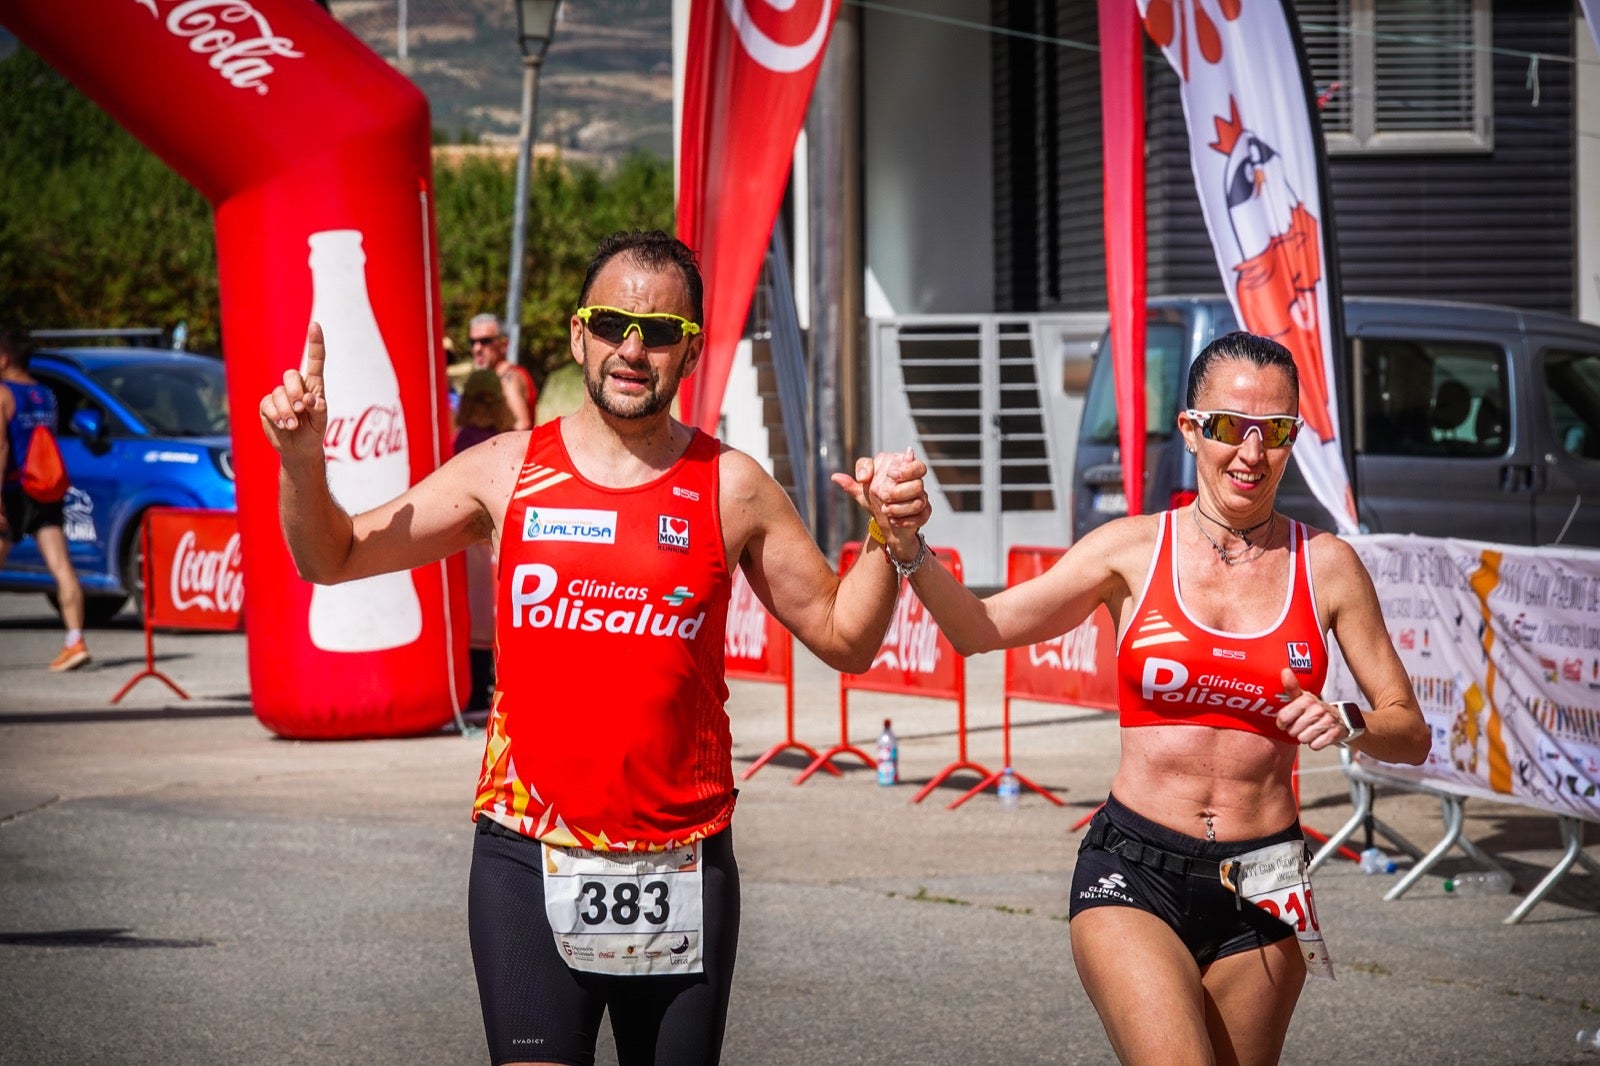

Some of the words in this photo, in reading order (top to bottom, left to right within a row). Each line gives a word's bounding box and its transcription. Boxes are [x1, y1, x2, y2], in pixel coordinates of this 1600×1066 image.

[662, 517, 668, 533] I
[660, 534, 688, 546] MOVE
[170, 530, 244, 613] Coca-Co
[567, 579, 649, 601] Clínicas
[511, 563, 705, 640] Polisalud
[1290, 644, 1296, 658] I
[1290, 658, 1312, 667] MOVE
[1141, 656, 1280, 718] Polisalu
[1197, 674, 1264, 695] Clínicas
[581, 881, 670, 925] 383
